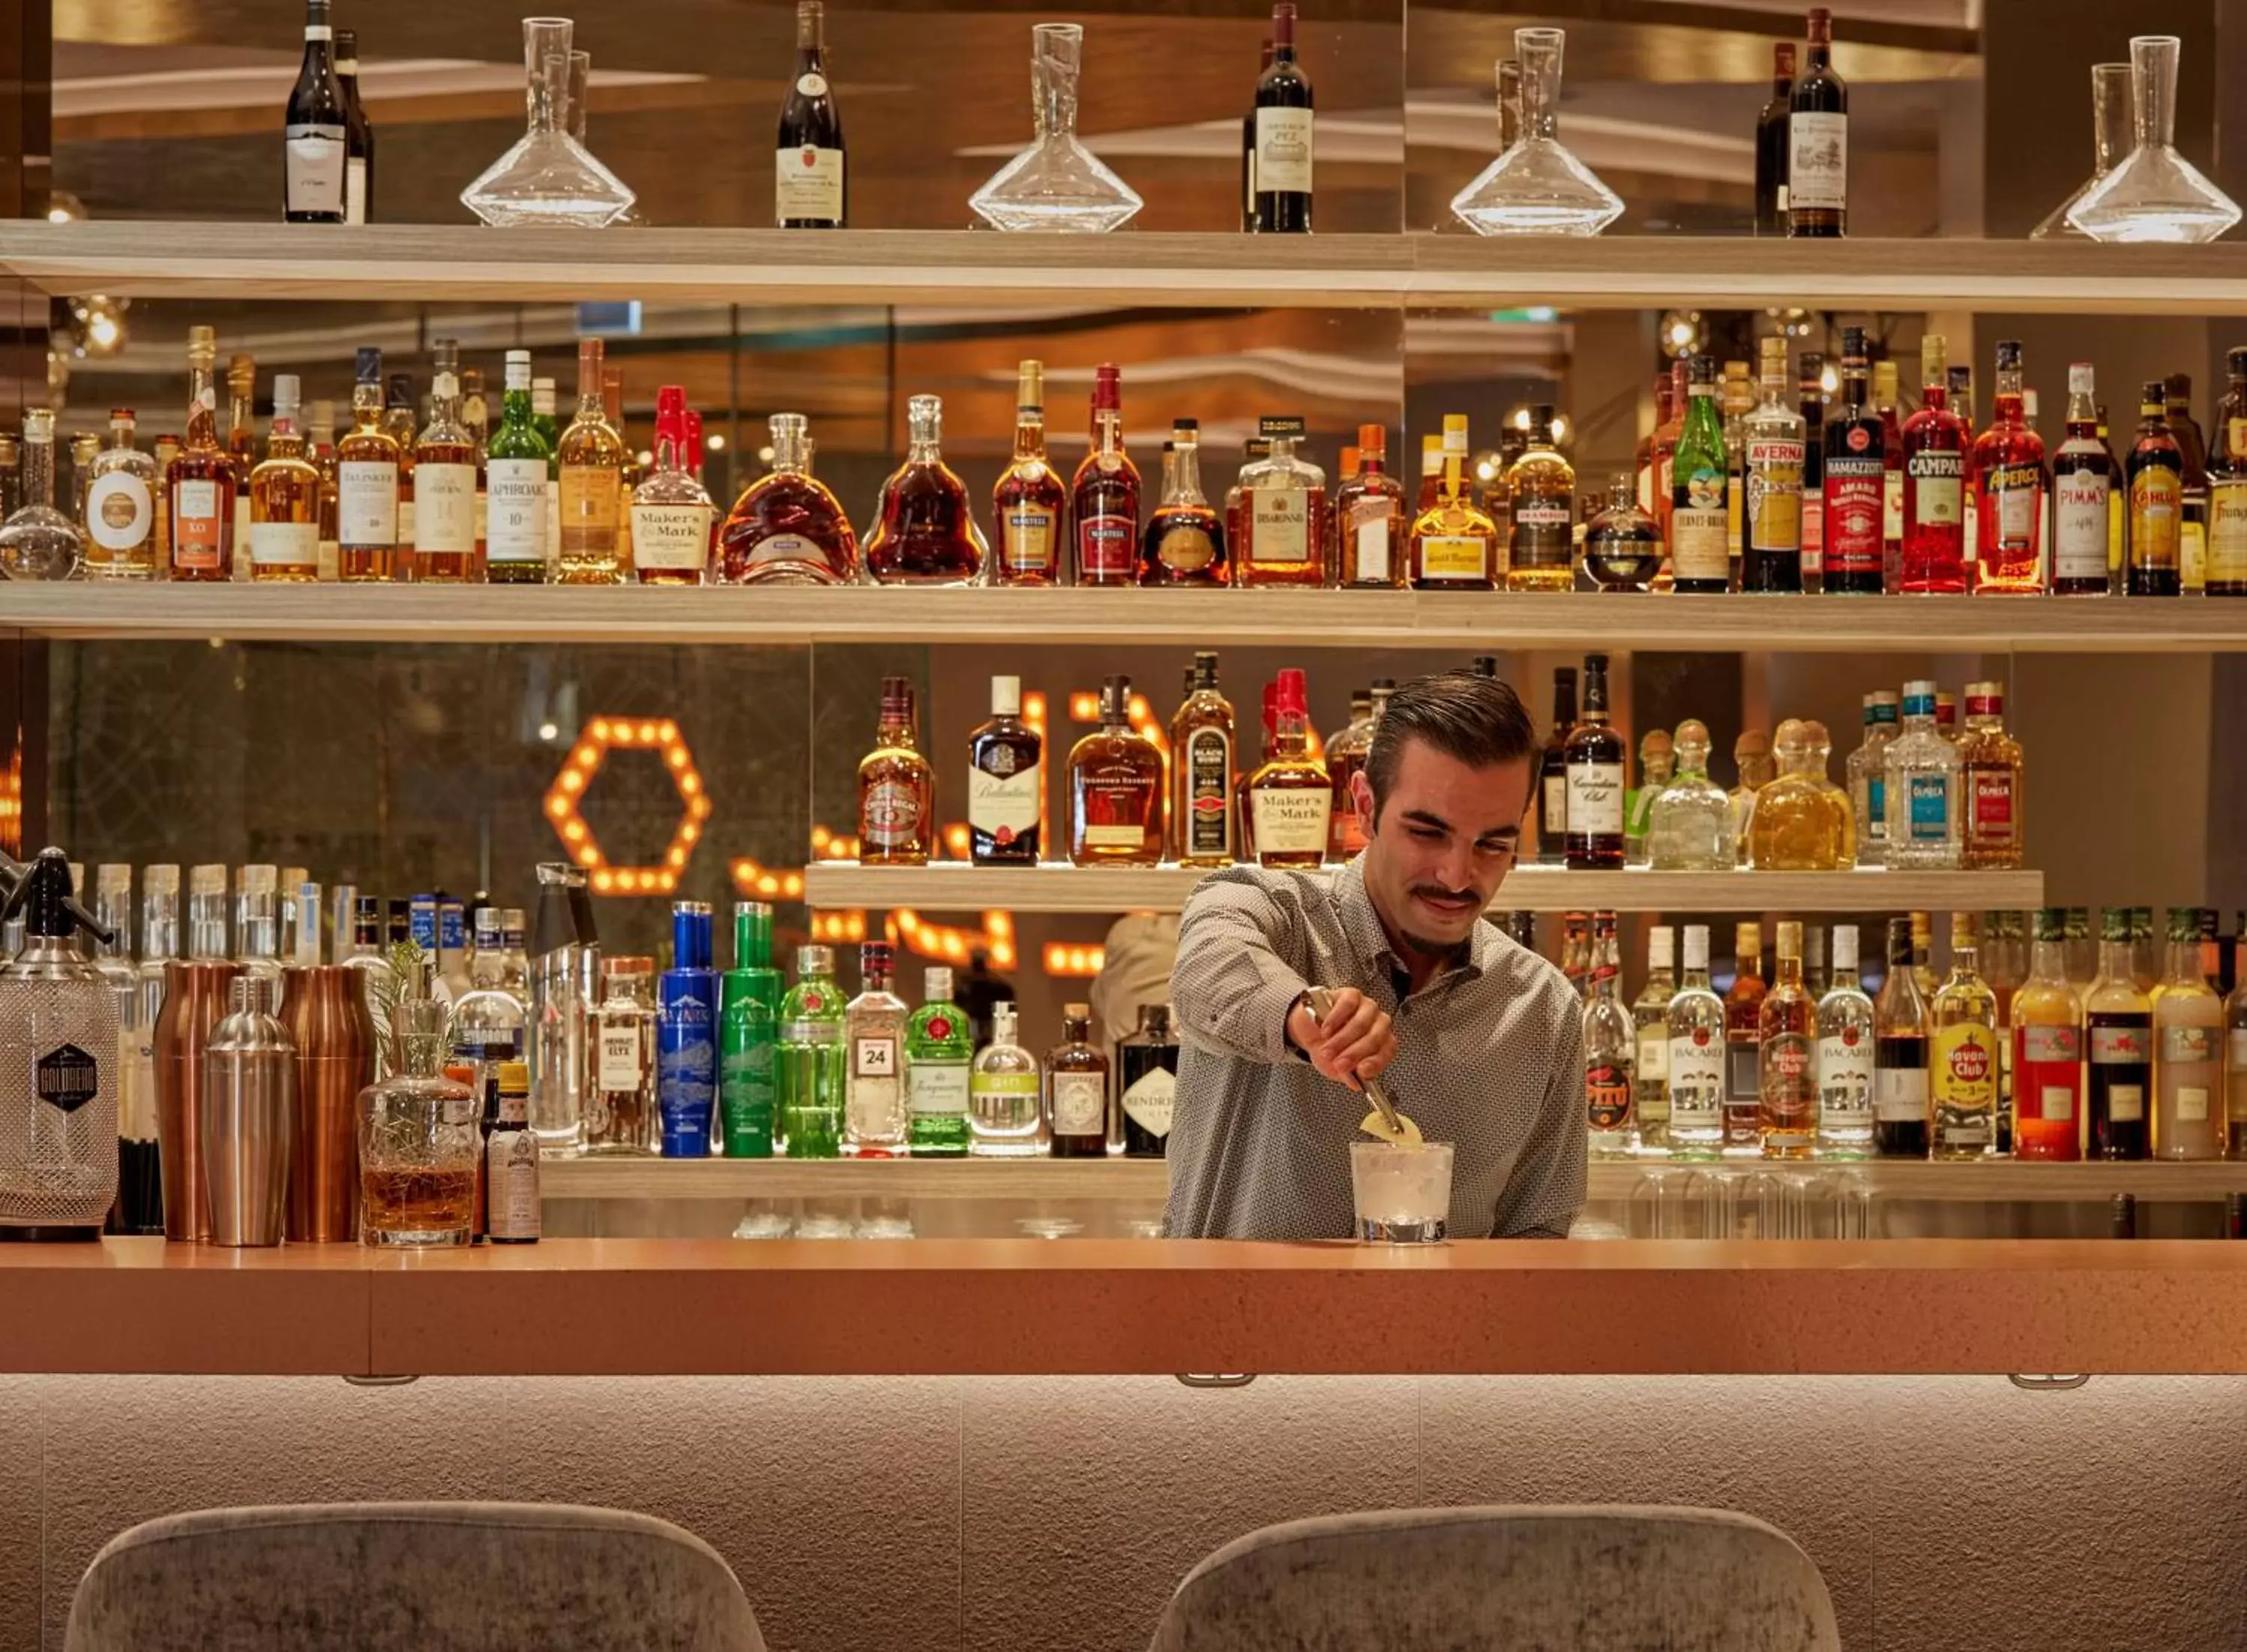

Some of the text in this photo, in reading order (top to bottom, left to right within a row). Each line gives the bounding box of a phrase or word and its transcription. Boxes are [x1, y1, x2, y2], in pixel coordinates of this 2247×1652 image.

[2060, 486, 2106, 506] PIMM'S
[510, 512, 522, 526] 10
[640, 512, 700, 523] Maker's
[658, 525, 698, 536] Mark
[1263, 796, 1322, 807] Maker's
[1281, 809, 1320, 819] Mark
[866, 1051, 885, 1064] 24
[1956, 1063, 1984, 1076] Club
[41, 1066, 94, 1093] GOLDBERG
